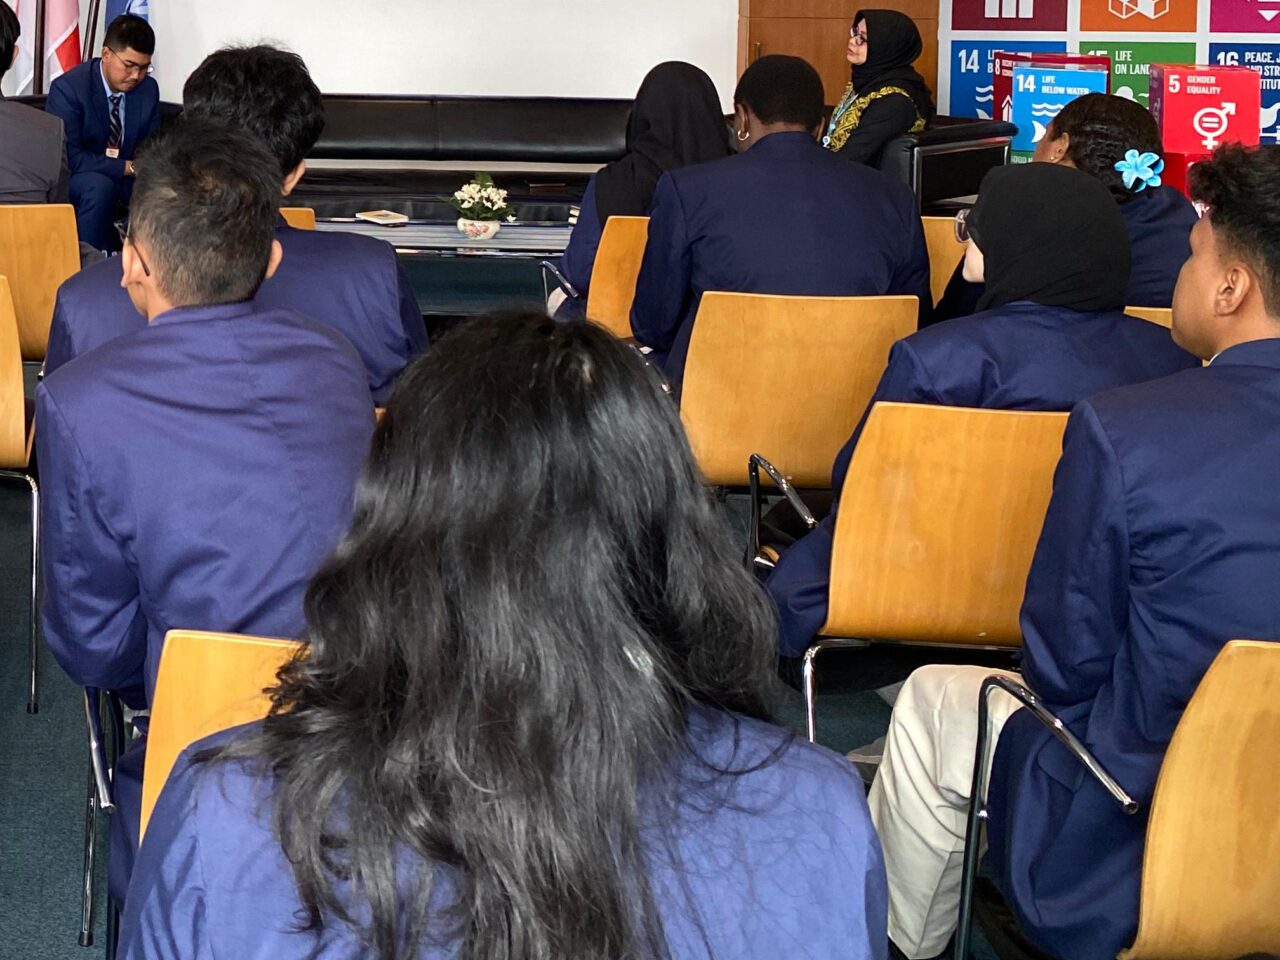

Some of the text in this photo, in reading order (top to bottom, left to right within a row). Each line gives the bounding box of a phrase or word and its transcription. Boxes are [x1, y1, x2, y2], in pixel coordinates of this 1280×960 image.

[958, 49, 980, 73] 14
[1115, 50, 1132, 61] LIFE
[1245, 51, 1275, 64] PEACE,
[995, 58, 1000, 75] 8
[1115, 63, 1127, 75] ON
[1016, 74, 1036, 93] 14
[1041, 75, 1056, 84] LIFE
[1168, 74, 1180, 93] 5
[1187, 75, 1216, 84] GENDER
[1041, 85, 1089, 96] BELOW WATER
[1186, 85, 1221, 95] EQUALITY
